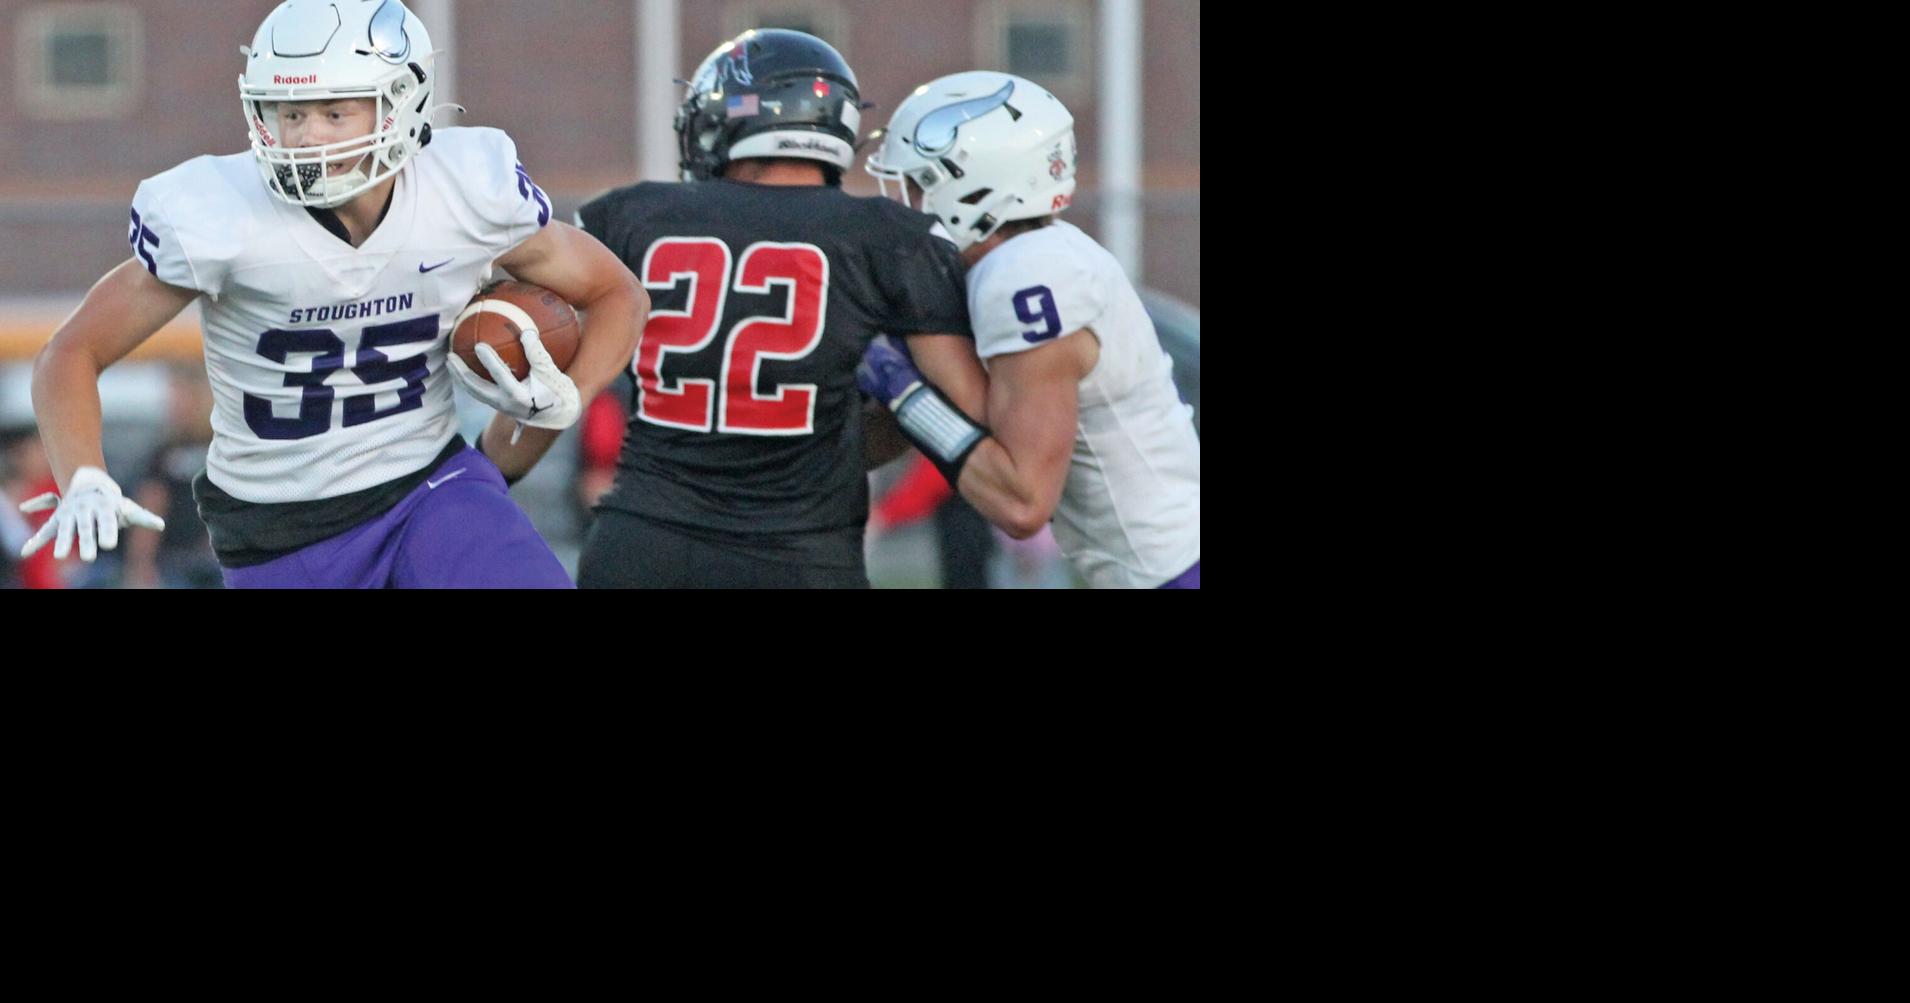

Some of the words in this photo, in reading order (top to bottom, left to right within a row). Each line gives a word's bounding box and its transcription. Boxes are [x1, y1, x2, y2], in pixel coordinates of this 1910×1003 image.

[273, 74, 317, 84] Riddell
[289, 293, 413, 323] STOUGHTON
[632, 236, 829, 436] 22
[1012, 285, 1062, 343] 9
[243, 315, 440, 440] 35
